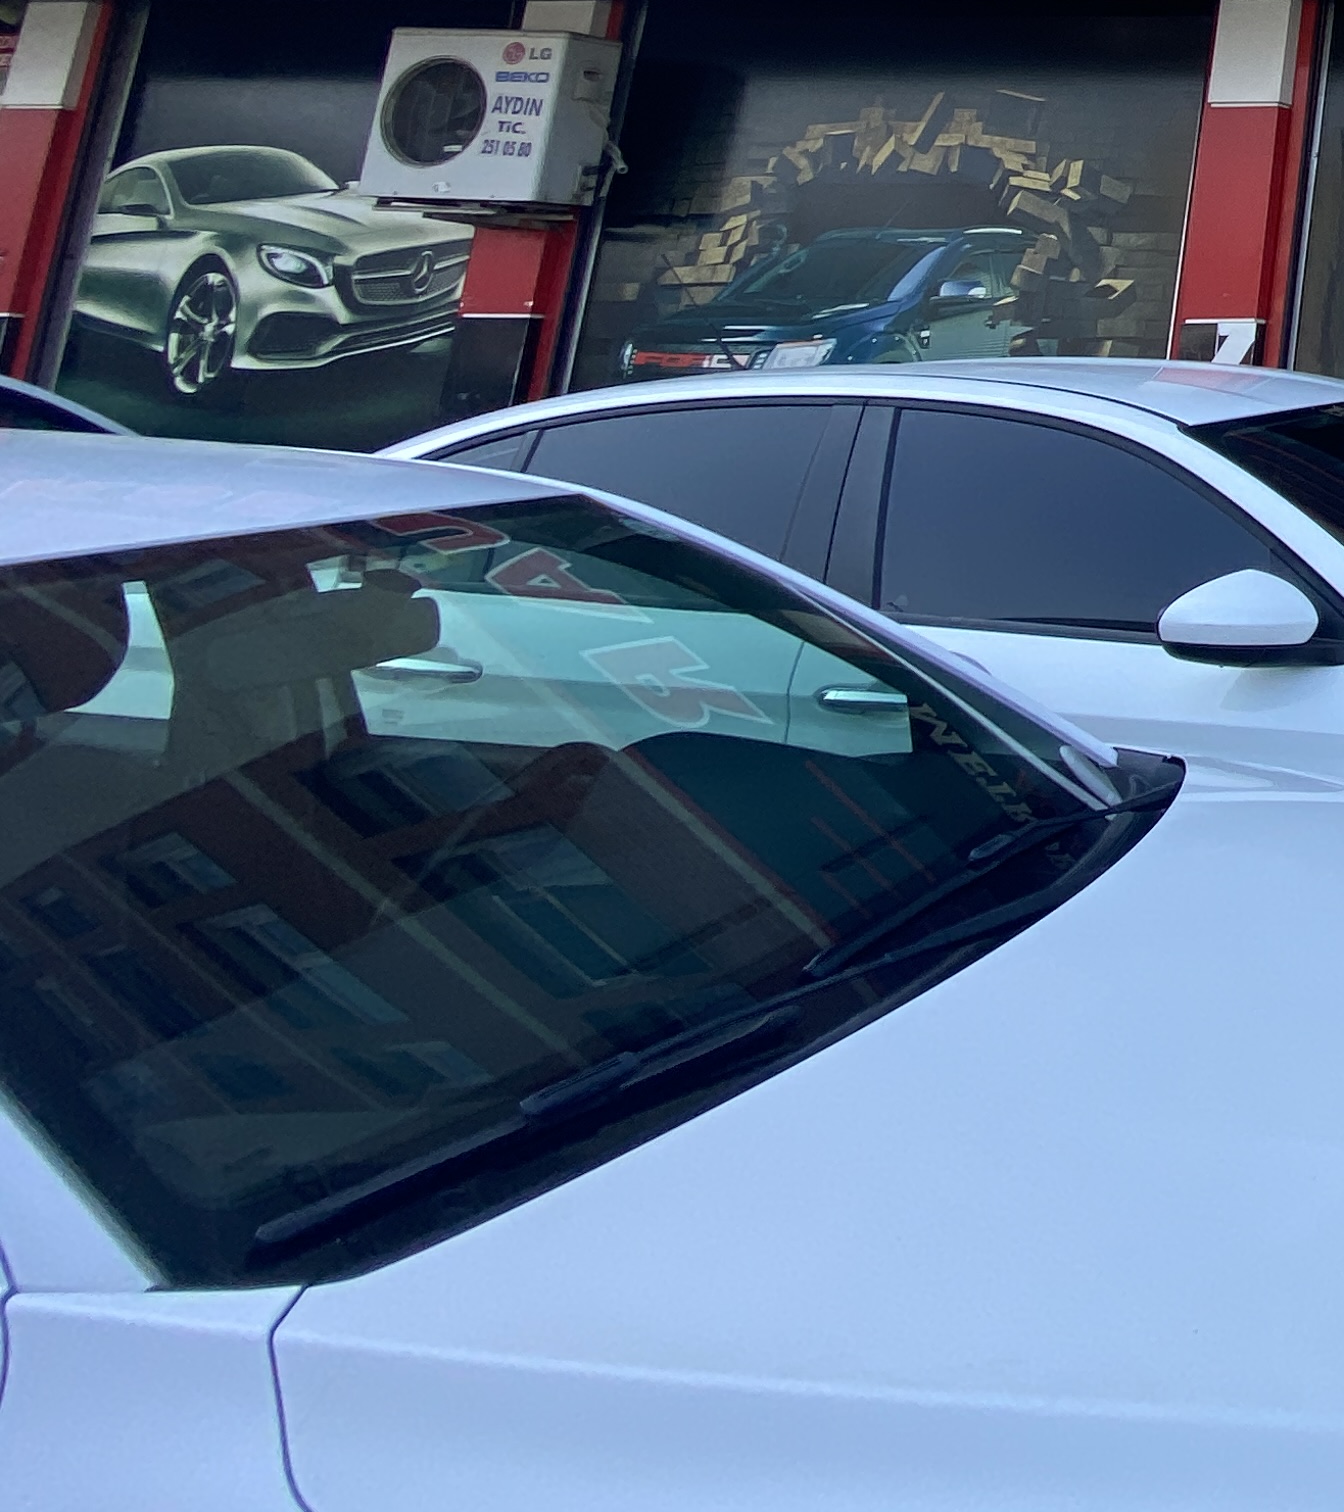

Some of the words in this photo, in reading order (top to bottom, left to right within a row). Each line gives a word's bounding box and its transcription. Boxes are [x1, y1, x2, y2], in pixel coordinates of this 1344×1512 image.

[529, 47, 552, 60] LG
[495, 71, 550, 83] BEKO
[491, 95, 544, 117] AYDIN
